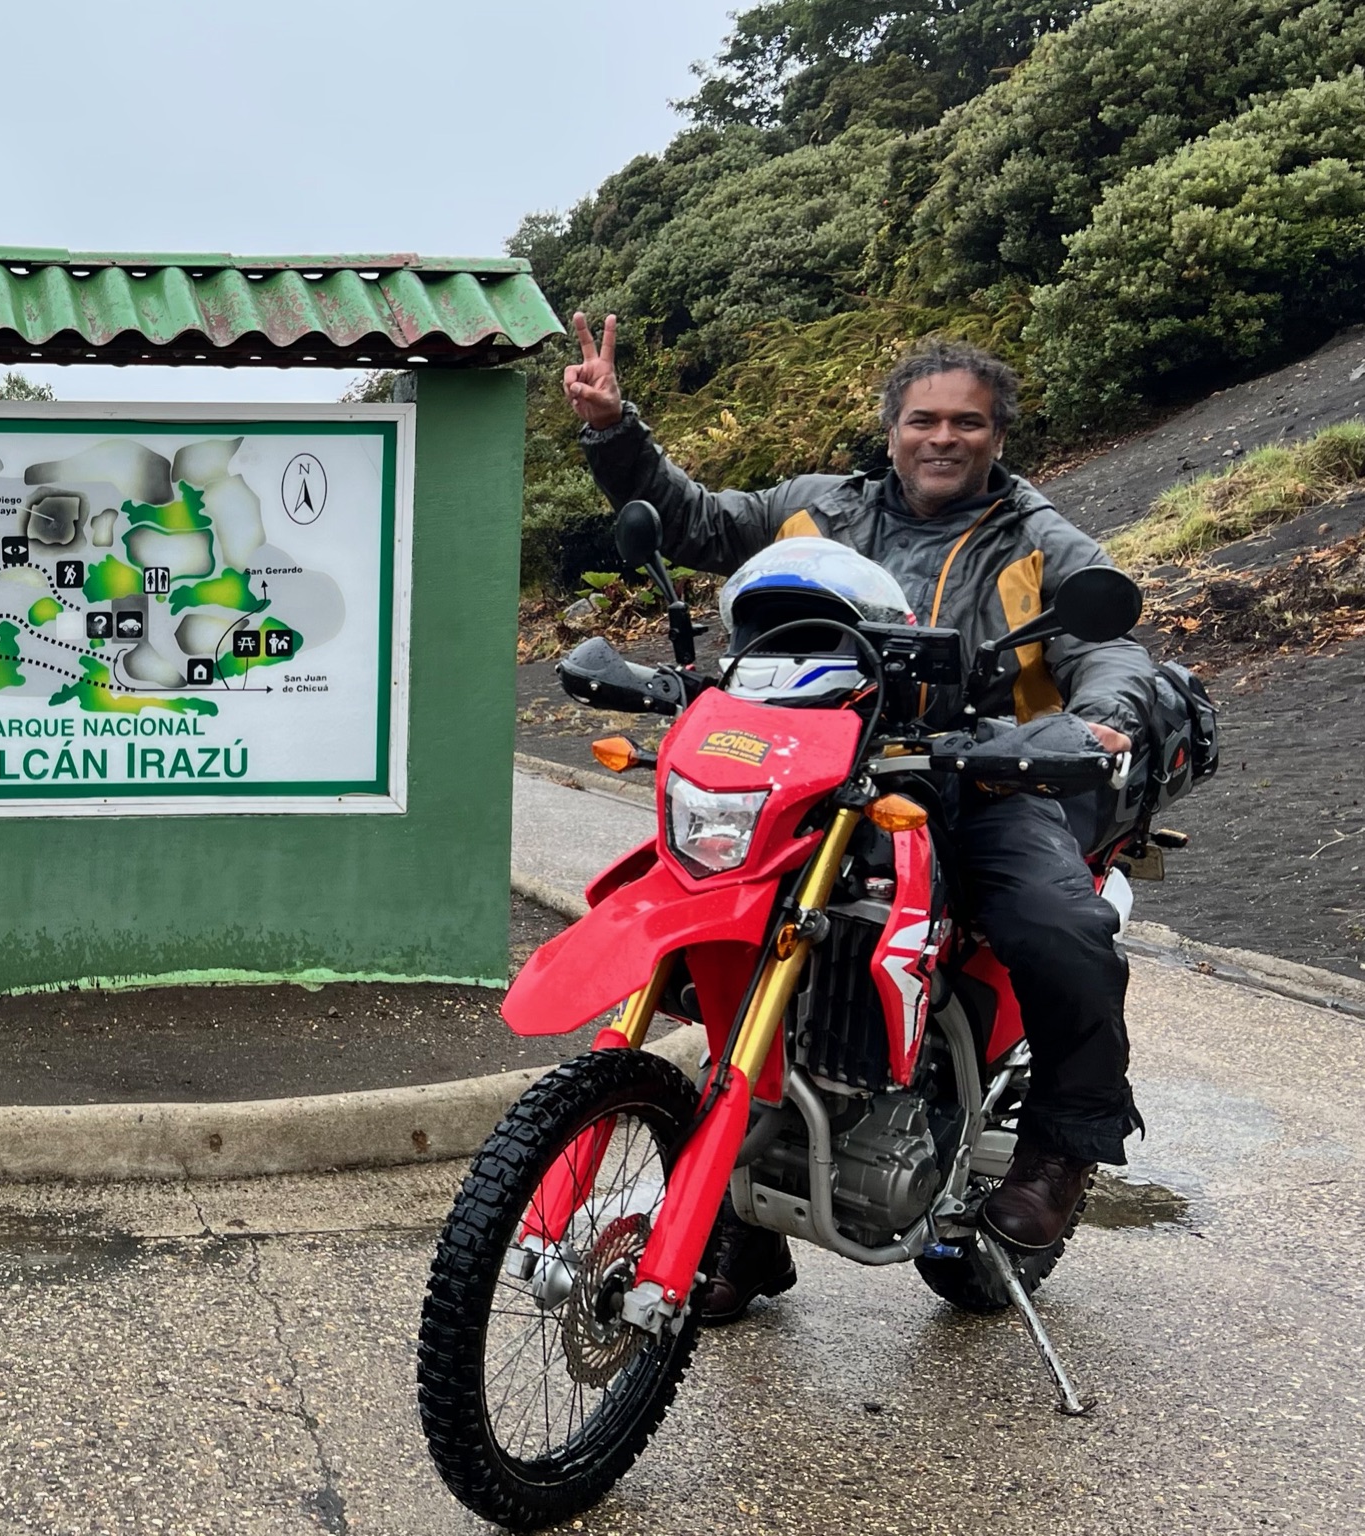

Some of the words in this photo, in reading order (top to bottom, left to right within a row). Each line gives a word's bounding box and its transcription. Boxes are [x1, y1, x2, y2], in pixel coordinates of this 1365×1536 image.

[297, 463, 311, 475] N
[244, 567, 264, 576] San
[265, 566, 303, 576] Gerardo
[284, 674, 302, 683] San
[304, 674, 327, 682] Juan
[282, 684, 294, 693] de
[296, 683, 329, 693] Chicuá
[83, 717, 206, 737] NACIONAL
[127, 738, 248, 779] IRAZÚ
